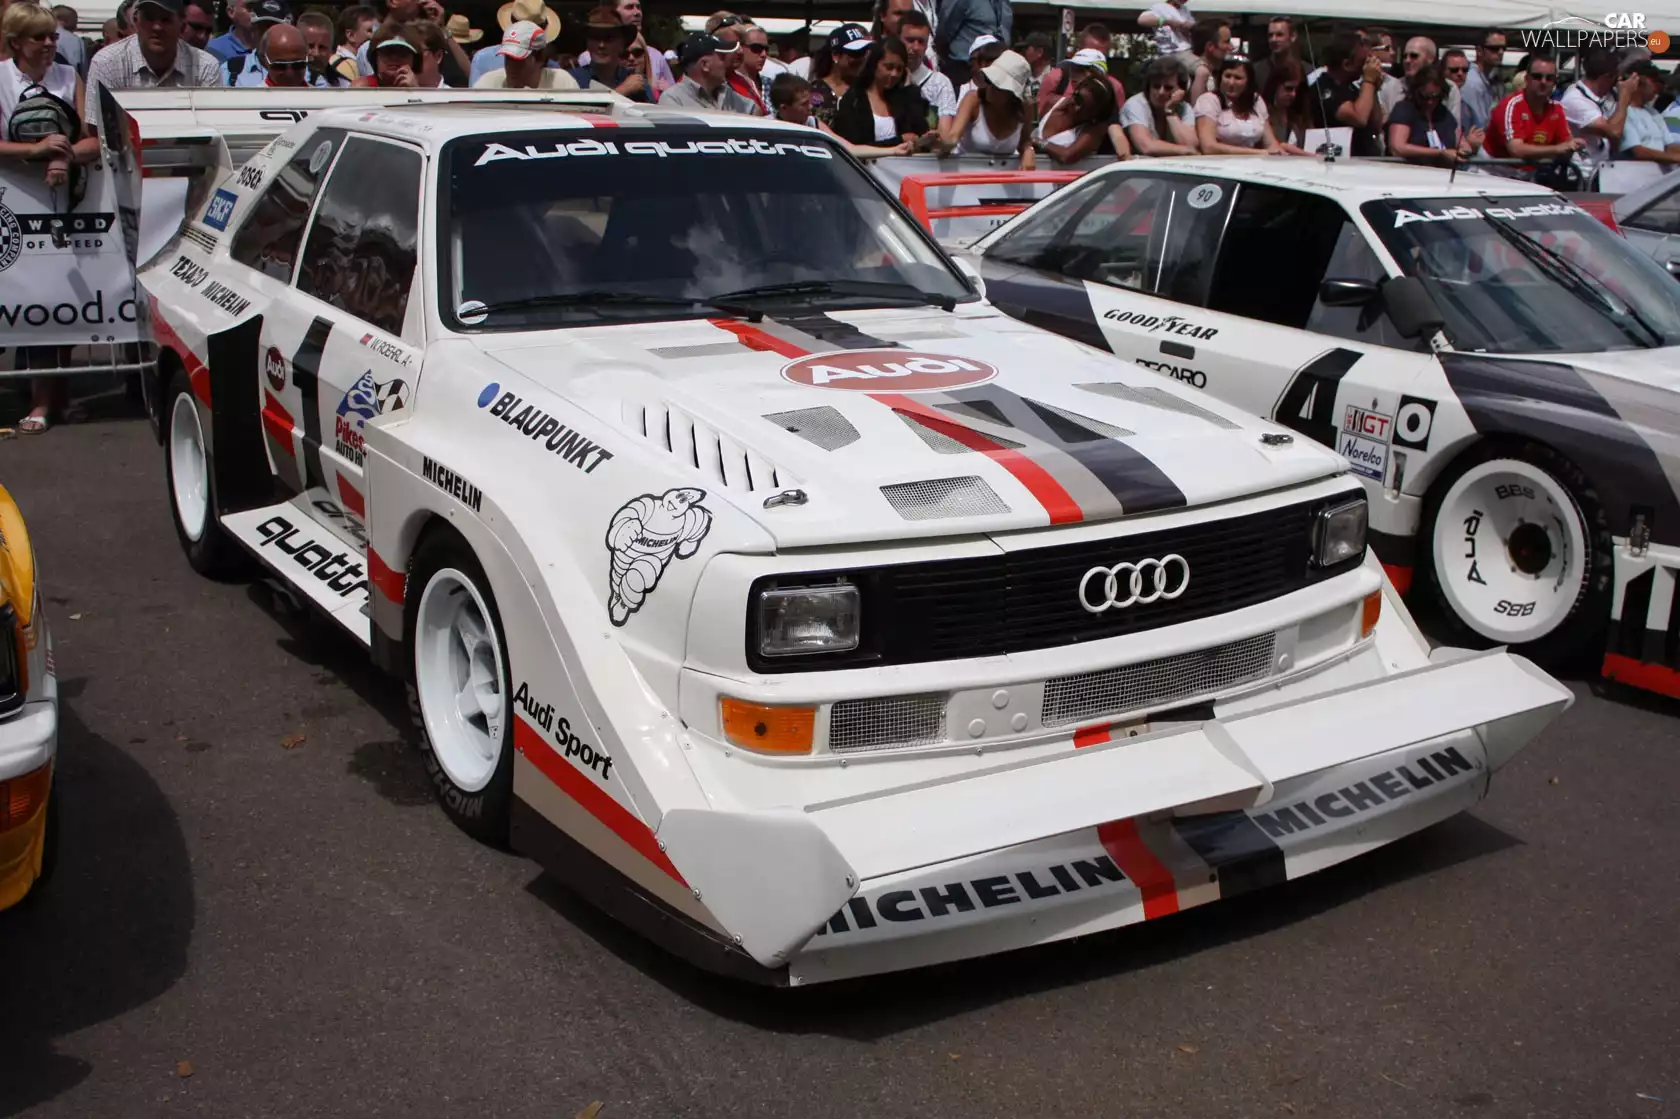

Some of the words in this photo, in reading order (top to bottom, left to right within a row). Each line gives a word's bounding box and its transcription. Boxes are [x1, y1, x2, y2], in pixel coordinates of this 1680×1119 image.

[474, 139, 619, 167] Audi
[624, 138, 833, 159] quattro
[207, 196, 234, 221] SKF
[1394, 206, 1484, 228] Audi
[28, 218, 107, 231] WOD
[26, 241, 46, 249] OF
[57, 239, 104, 249] PEED
[169, 255, 210, 288] TEXACO
[200, 280, 251, 317] MICHELIN
[266, 356, 285, 381] Audi
[807, 358, 981, 385] Audi
[335, 416, 365, 449] Pikes
[489, 391, 615, 475] BLAUPUNKT
[335, 440, 353, 462] AUTO
[1342, 437, 1382, 466] Norelco
[422, 456, 483, 513] MICHELIN
[1495, 485, 1536, 500] BBS
[635, 534, 680, 548] MICHELIN
[1463, 509, 1488, 586] Audi
[1493, 600, 1536, 617] BBS
[513, 681, 556, 734] Audi
[555, 717, 613, 780] Sport
[1252, 746, 1474, 839] MICHELIN
